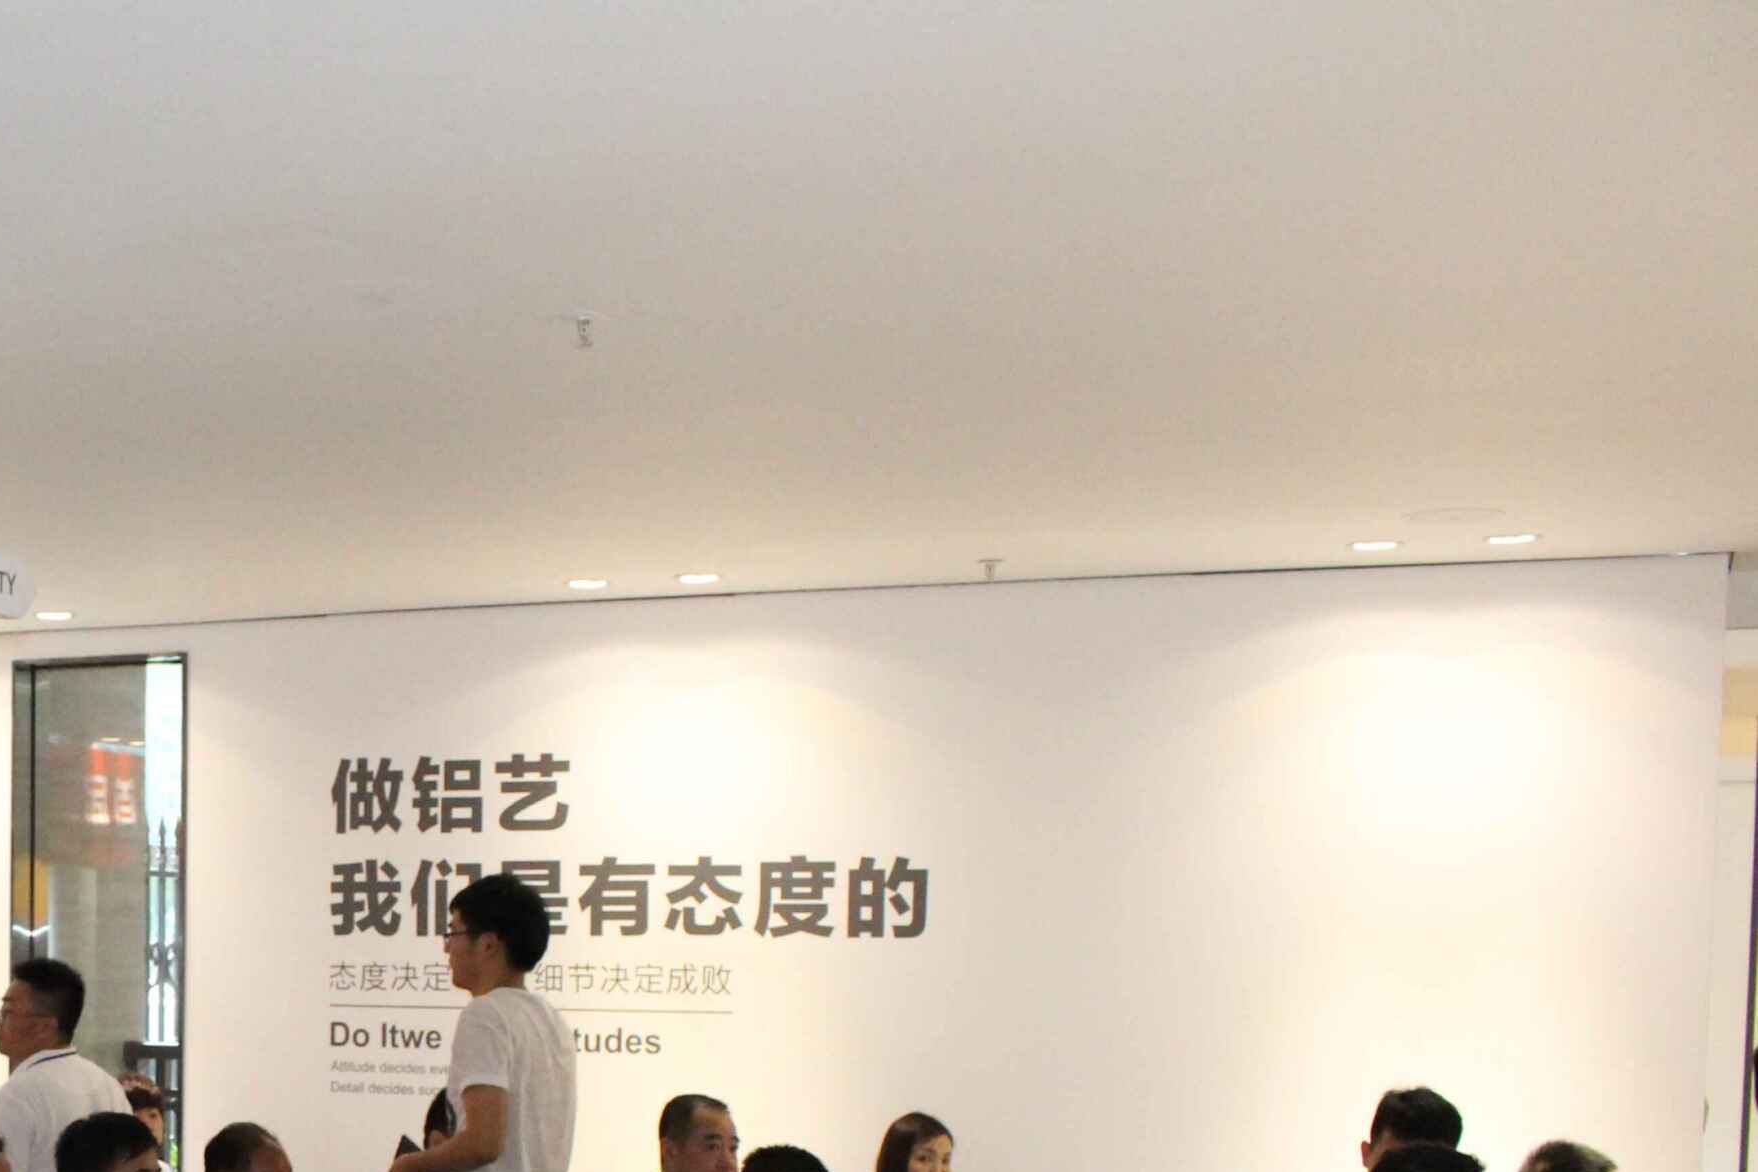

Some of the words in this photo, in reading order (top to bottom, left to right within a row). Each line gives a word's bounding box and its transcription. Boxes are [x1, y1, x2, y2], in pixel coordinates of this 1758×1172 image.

[331, 753, 570, 834] 做铝艺
[534, 963, 733, 995] 细节决定成败
[330, 1022, 369, 1047] Do
[573, 1027, 662, 1054] tudes
